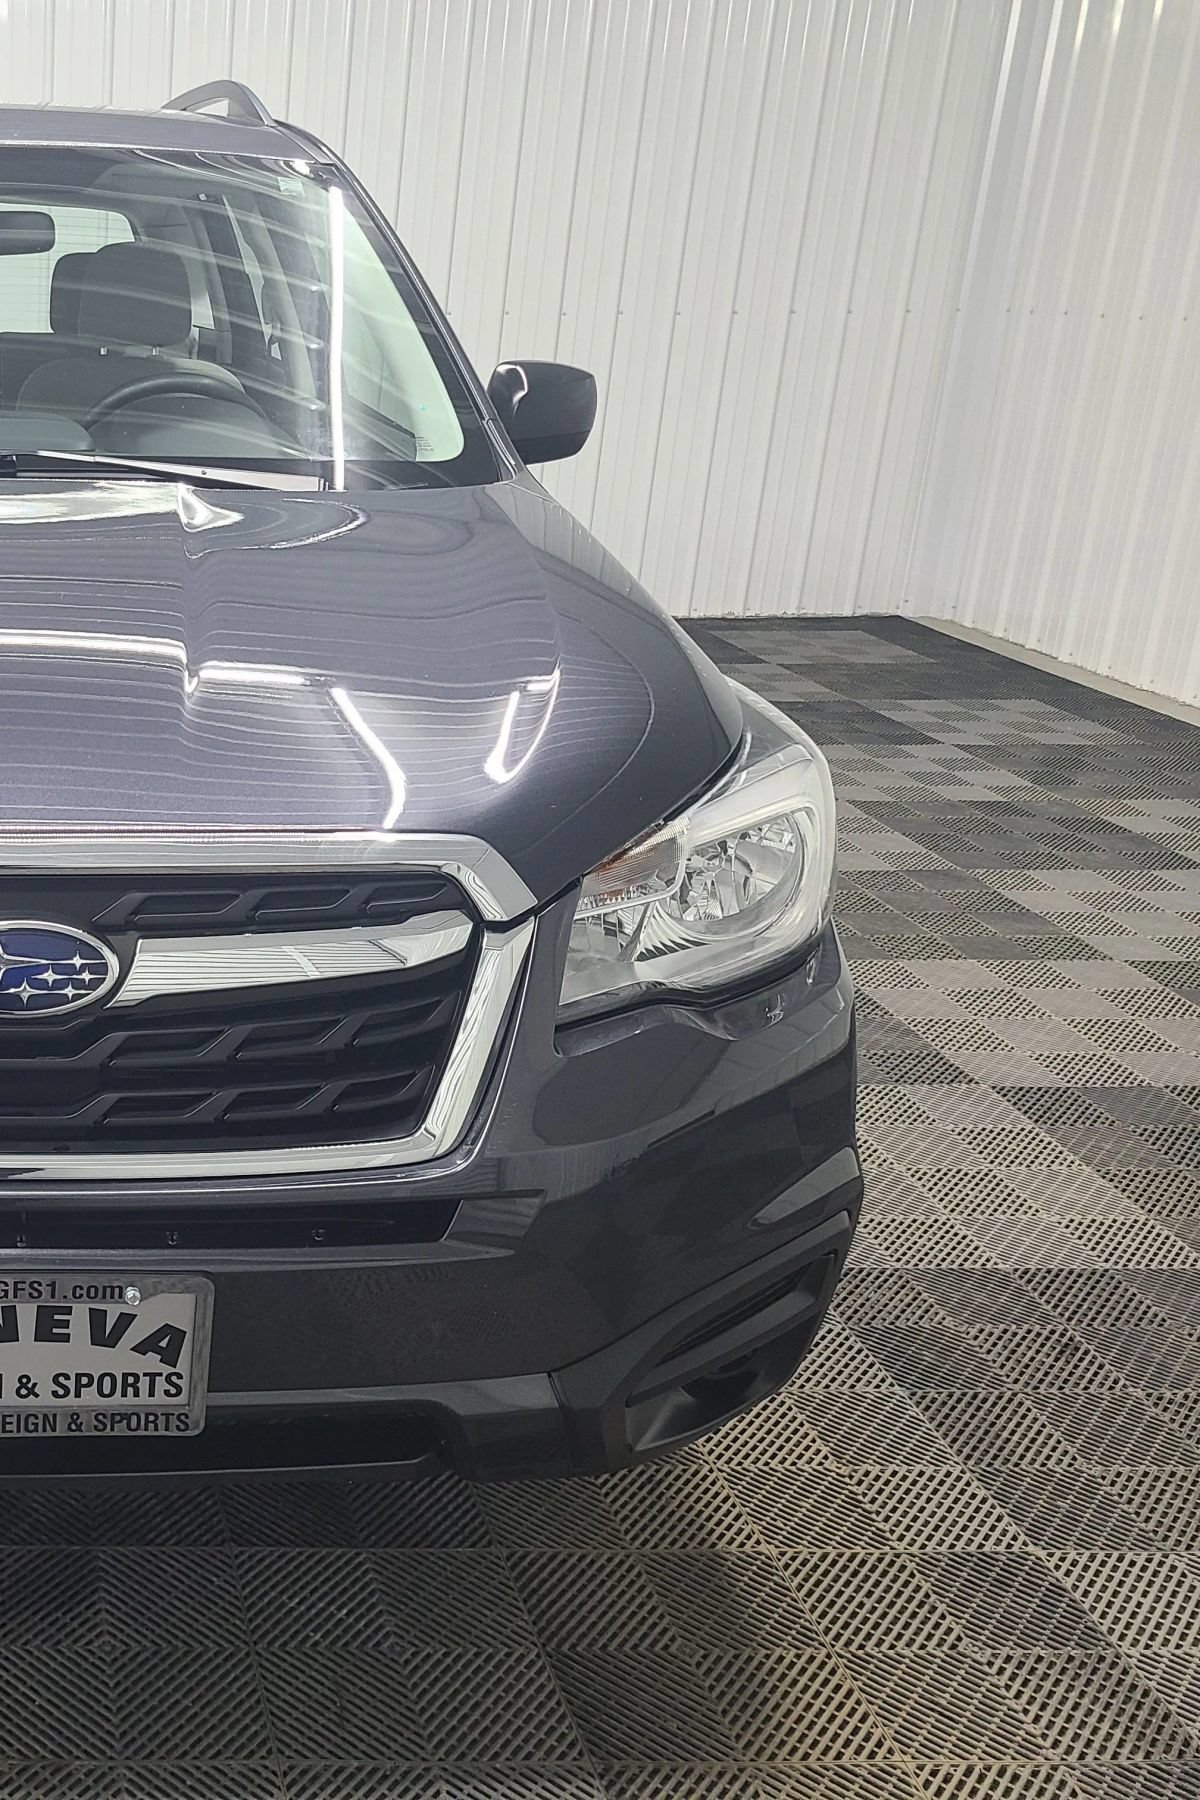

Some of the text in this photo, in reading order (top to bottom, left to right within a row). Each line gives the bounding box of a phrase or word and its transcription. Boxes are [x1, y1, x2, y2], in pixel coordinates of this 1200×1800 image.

[15, 1375, 41, 1399] &
[51, 1371, 184, 1399] SPORTS
[67, 1413, 84, 1433] &
[93, 1411, 190, 1434] SPORTS
